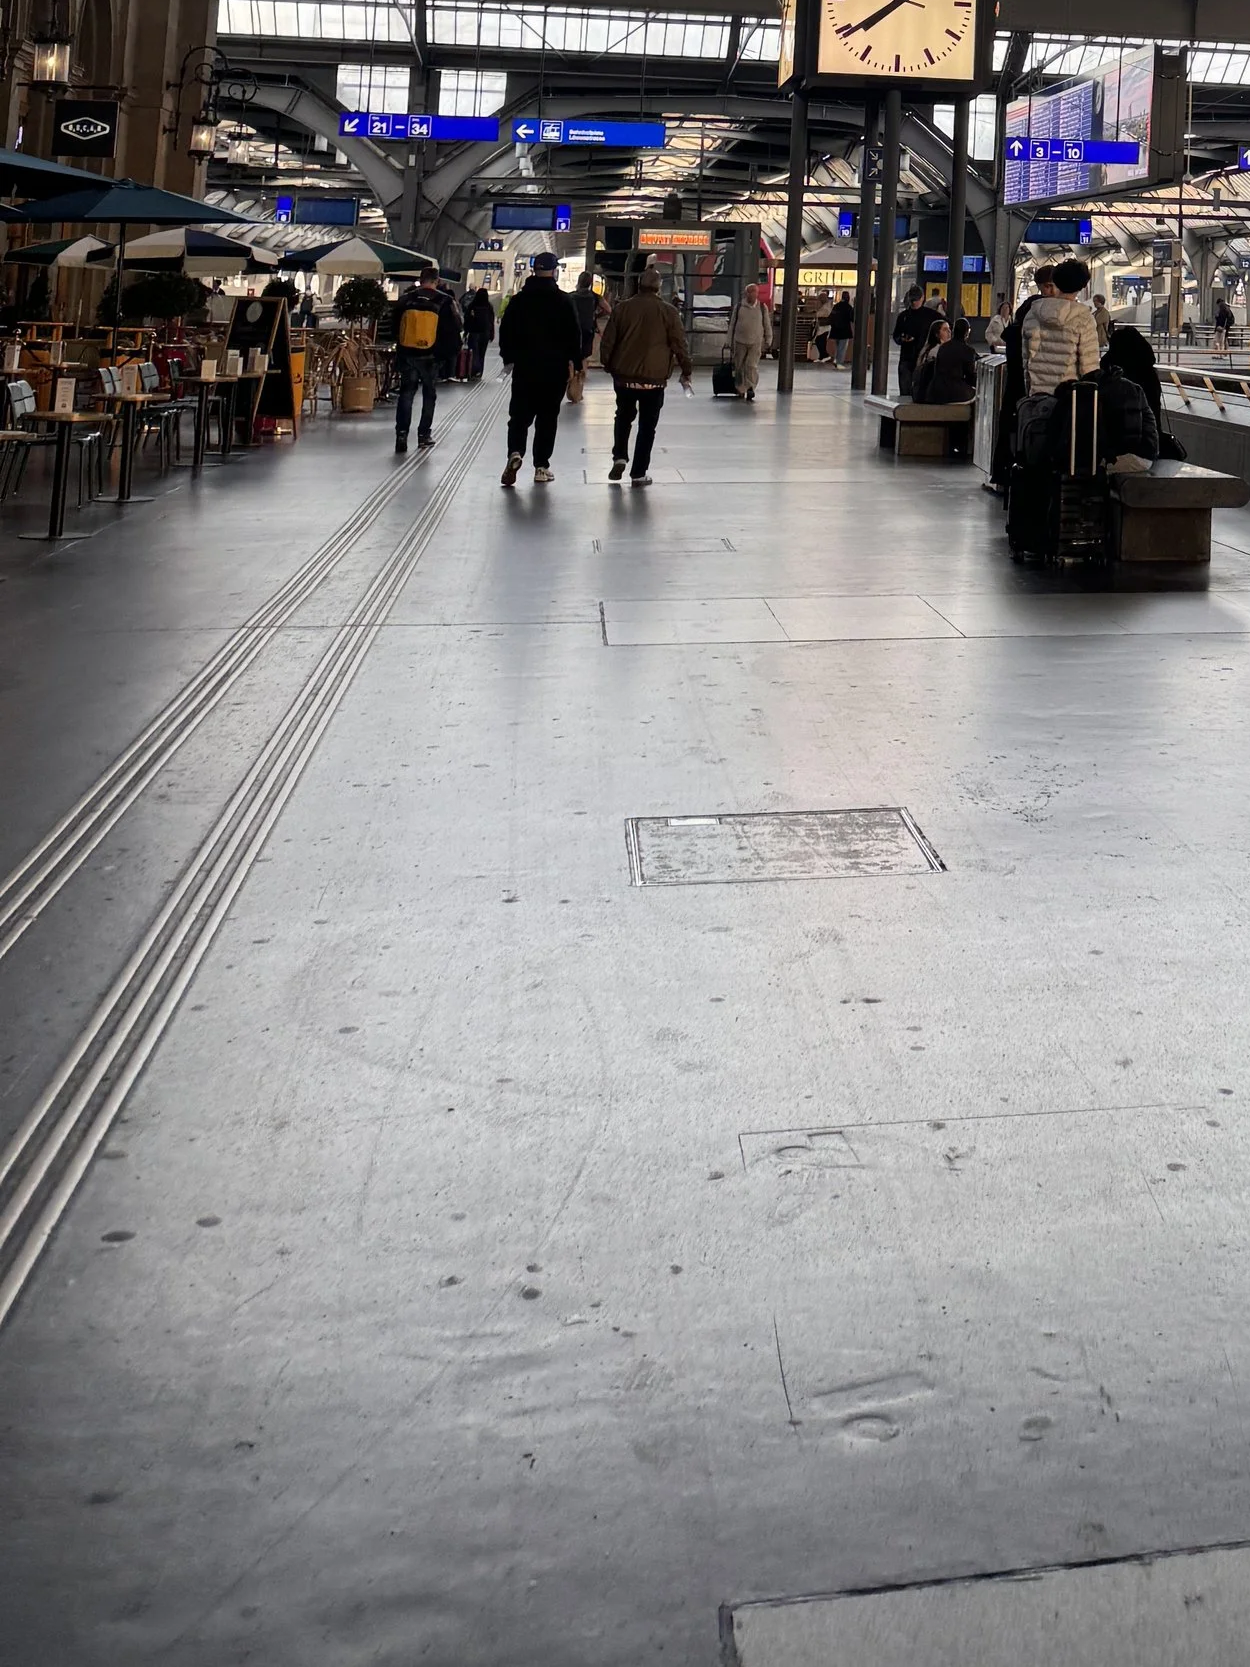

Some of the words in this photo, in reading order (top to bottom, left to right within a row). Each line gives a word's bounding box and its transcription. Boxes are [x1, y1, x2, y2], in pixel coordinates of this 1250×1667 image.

[372, 121, 387, 133] 21
[411, 123, 428, 135] 34
[1035, 147, 1044, 158] 3
[1067, 148, 1080, 159] 10
